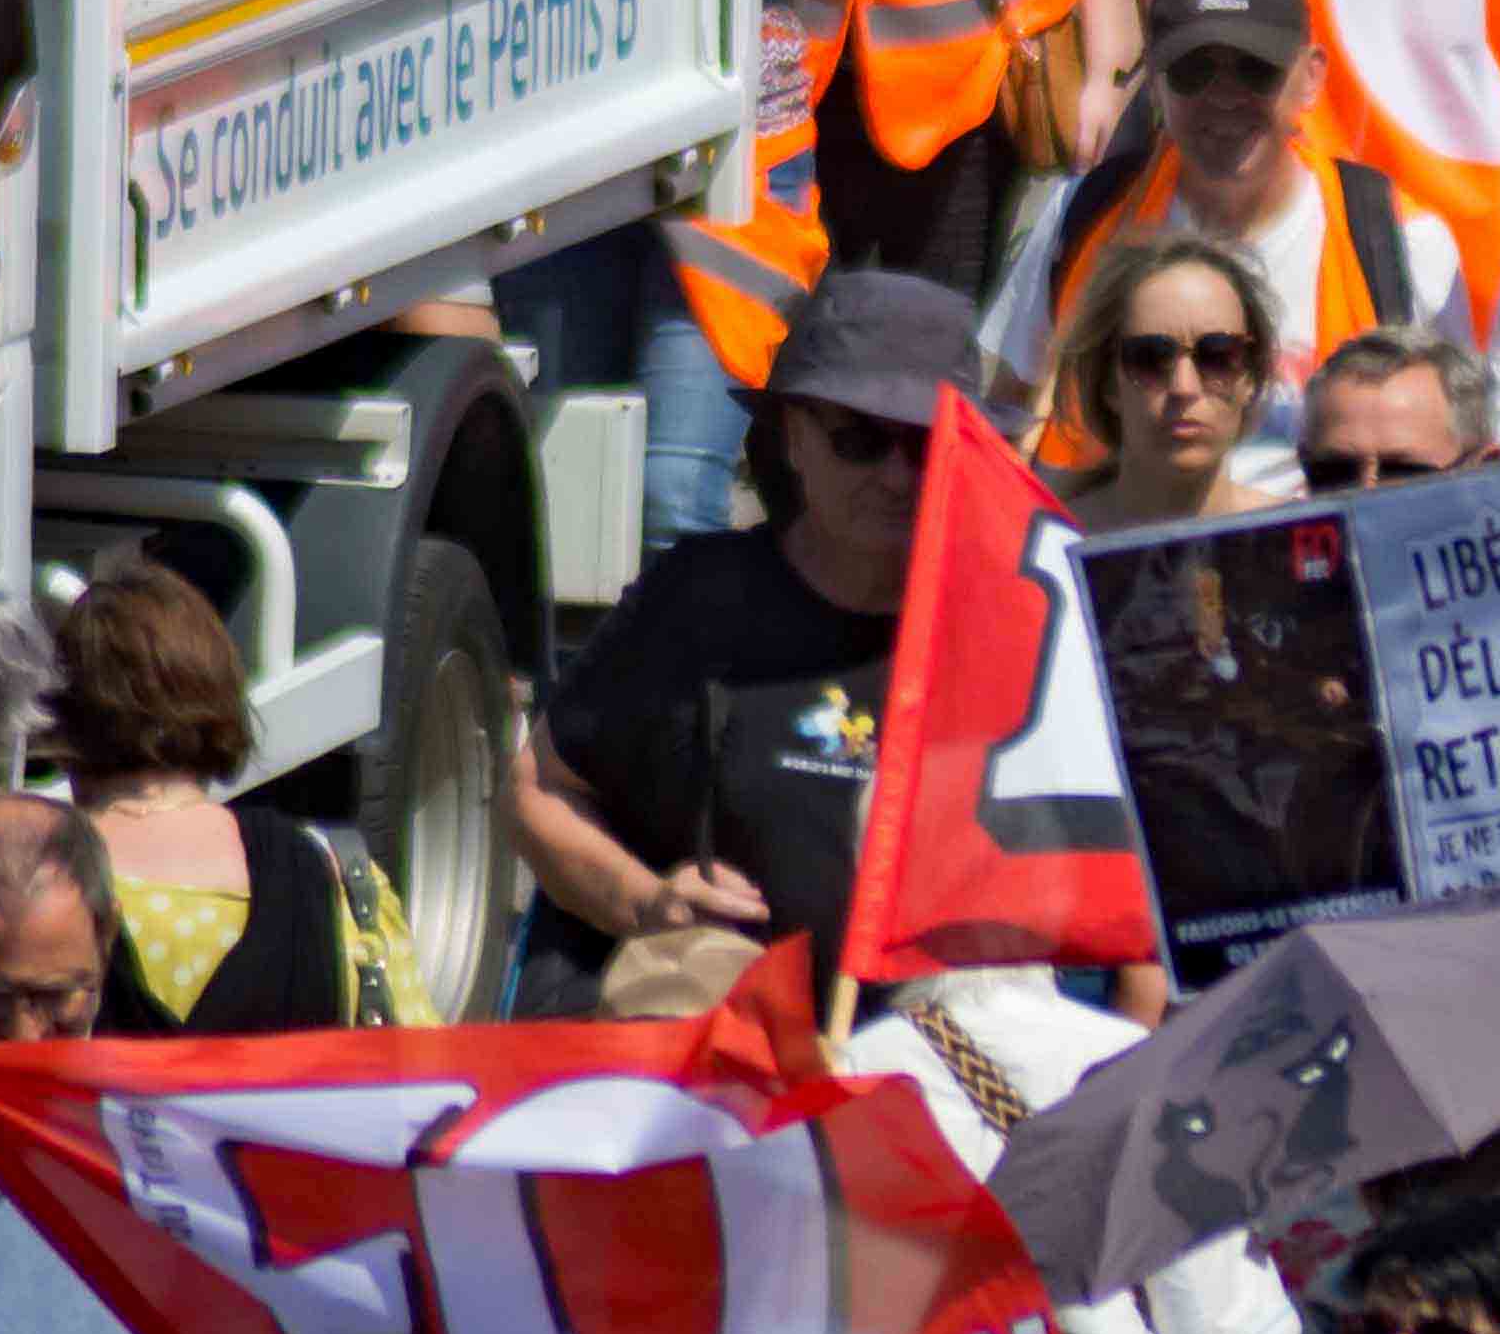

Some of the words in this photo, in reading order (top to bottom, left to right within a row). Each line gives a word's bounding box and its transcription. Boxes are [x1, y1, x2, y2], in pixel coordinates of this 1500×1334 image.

[155, 105, 200, 240] Se
[210, 40, 346, 219] conduit
[355, 32, 436, 164] avec
